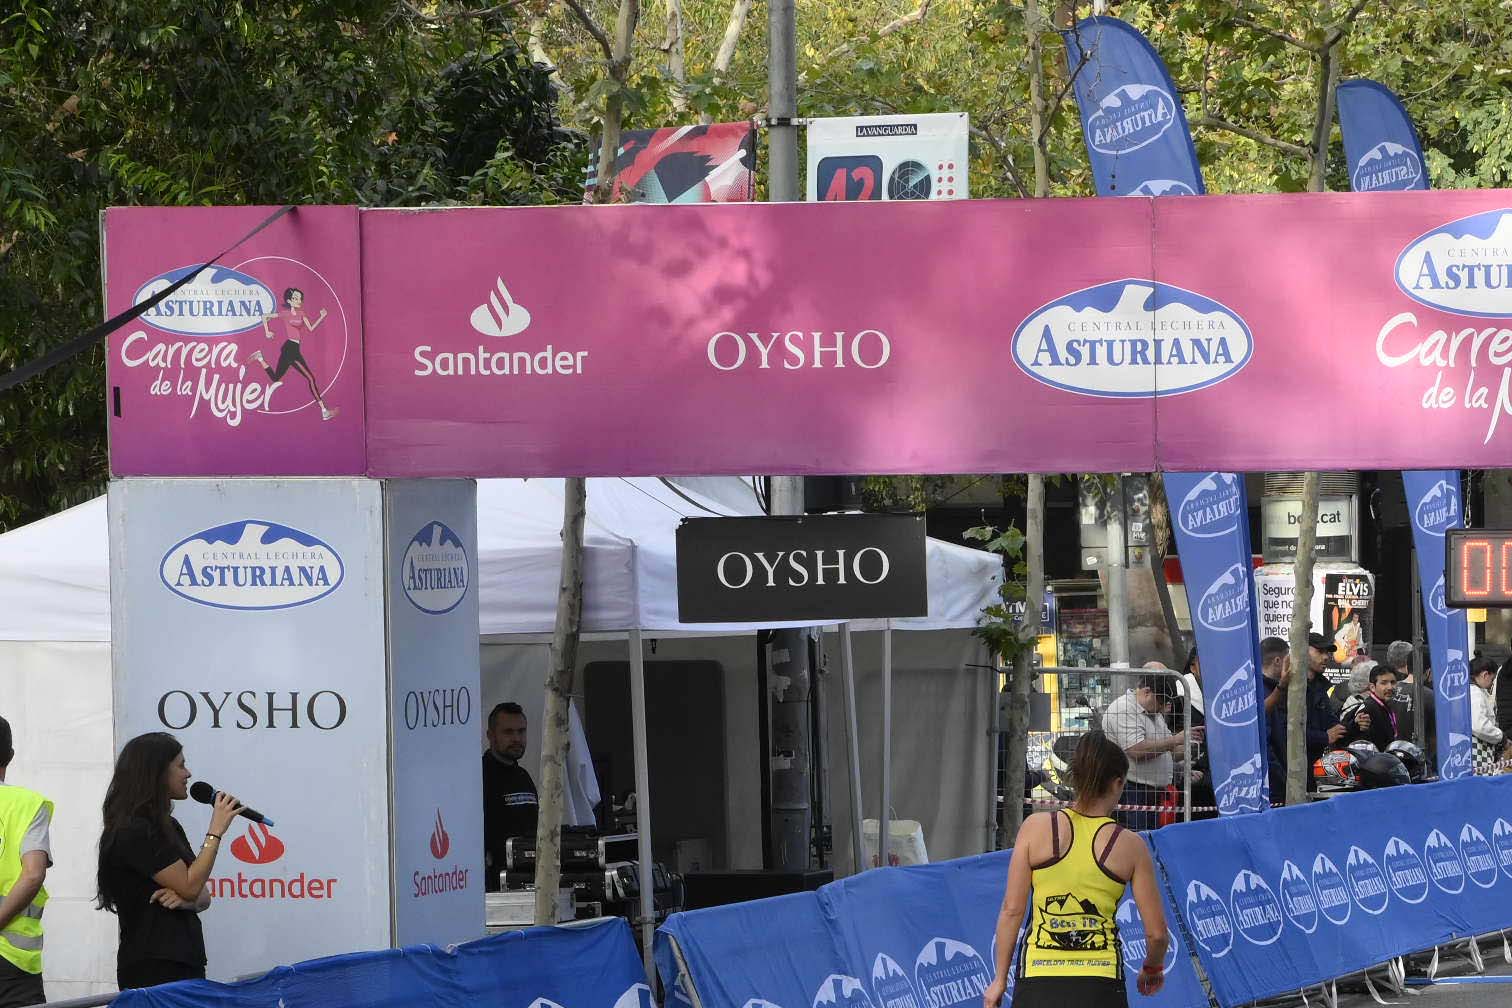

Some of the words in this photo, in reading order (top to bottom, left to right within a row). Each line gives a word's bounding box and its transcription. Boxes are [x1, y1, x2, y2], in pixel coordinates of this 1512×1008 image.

[867, 125, 916, 135] VANGUARDIA
[144, 291, 264, 317] ASTURIANA
[173, 288, 210, 297] ENTRAL
[1067, 320, 1145, 332] CENTRAL
[1150, 318, 1227, 331] LECHERA
[121, 331, 239, 368] Carrera
[706, 329, 891, 371] OYSHO
[1030, 324, 1234, 368] ASTURIANA
[413, 347, 587, 377] Santander
[150, 370, 172, 396] de
[177, 370, 192, 396] la
[190, 364, 283, 427] Mujer
[1421, 371, 1456, 409] de
[1464, 370, 1489, 409] la
[1288, 510, 1341, 525] b.cat
[175, 554, 331, 588] ASTURIANA
[202, 552, 260, 561] CENTRAL
[266, 551, 324, 560] LECHERA
[716, 547, 890, 589] OYSHO
[407, 555, 466, 592] ASTURIANA
[1337, 583, 1369, 596] ELVIS
[1264, 602, 1279, 612] que
[157, 690, 347, 730] OYSHO
[405, 685, 471, 730] OYSHO
[208, 872, 337, 899] antander
[413, 865, 469, 898] Santander
[1032, 959, 1065, 967] BARCELONA
